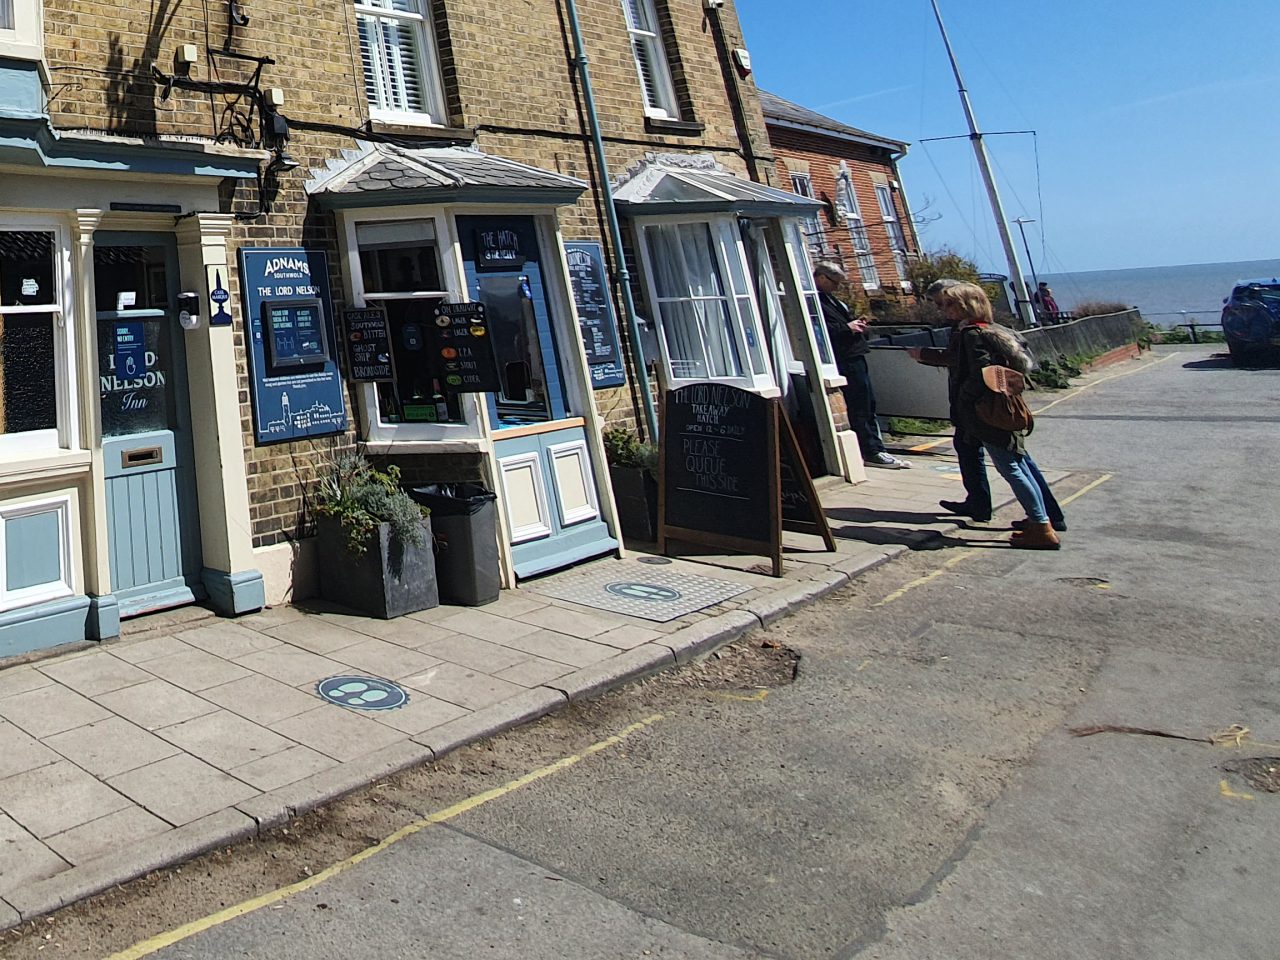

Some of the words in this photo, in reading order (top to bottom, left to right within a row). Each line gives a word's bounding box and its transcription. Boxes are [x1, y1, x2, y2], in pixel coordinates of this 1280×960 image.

[481, 231, 496, 248] THE
[258, 287, 272, 296] THE
[275, 286, 293, 295] LORD
[296, 285, 321, 295] NELSON
[353, 344, 376, 352] GHOST
[355, 352, 370, 361] SHIP
[122, 392, 148, 410] Inn
[674, 389, 690, 404] THE
[691, 385, 709, 405] LORD
[712, 385, 751, 409] NELSON
[691, 403, 730, 417] TAKEAWAY
[696, 414, 719, 424] HATCH
[683, 438, 721, 457] PLEASE
[685, 455, 727, 475] QUEUE
[696, 473, 717, 490] THIS
[718, 474, 739, 491] SIDE
